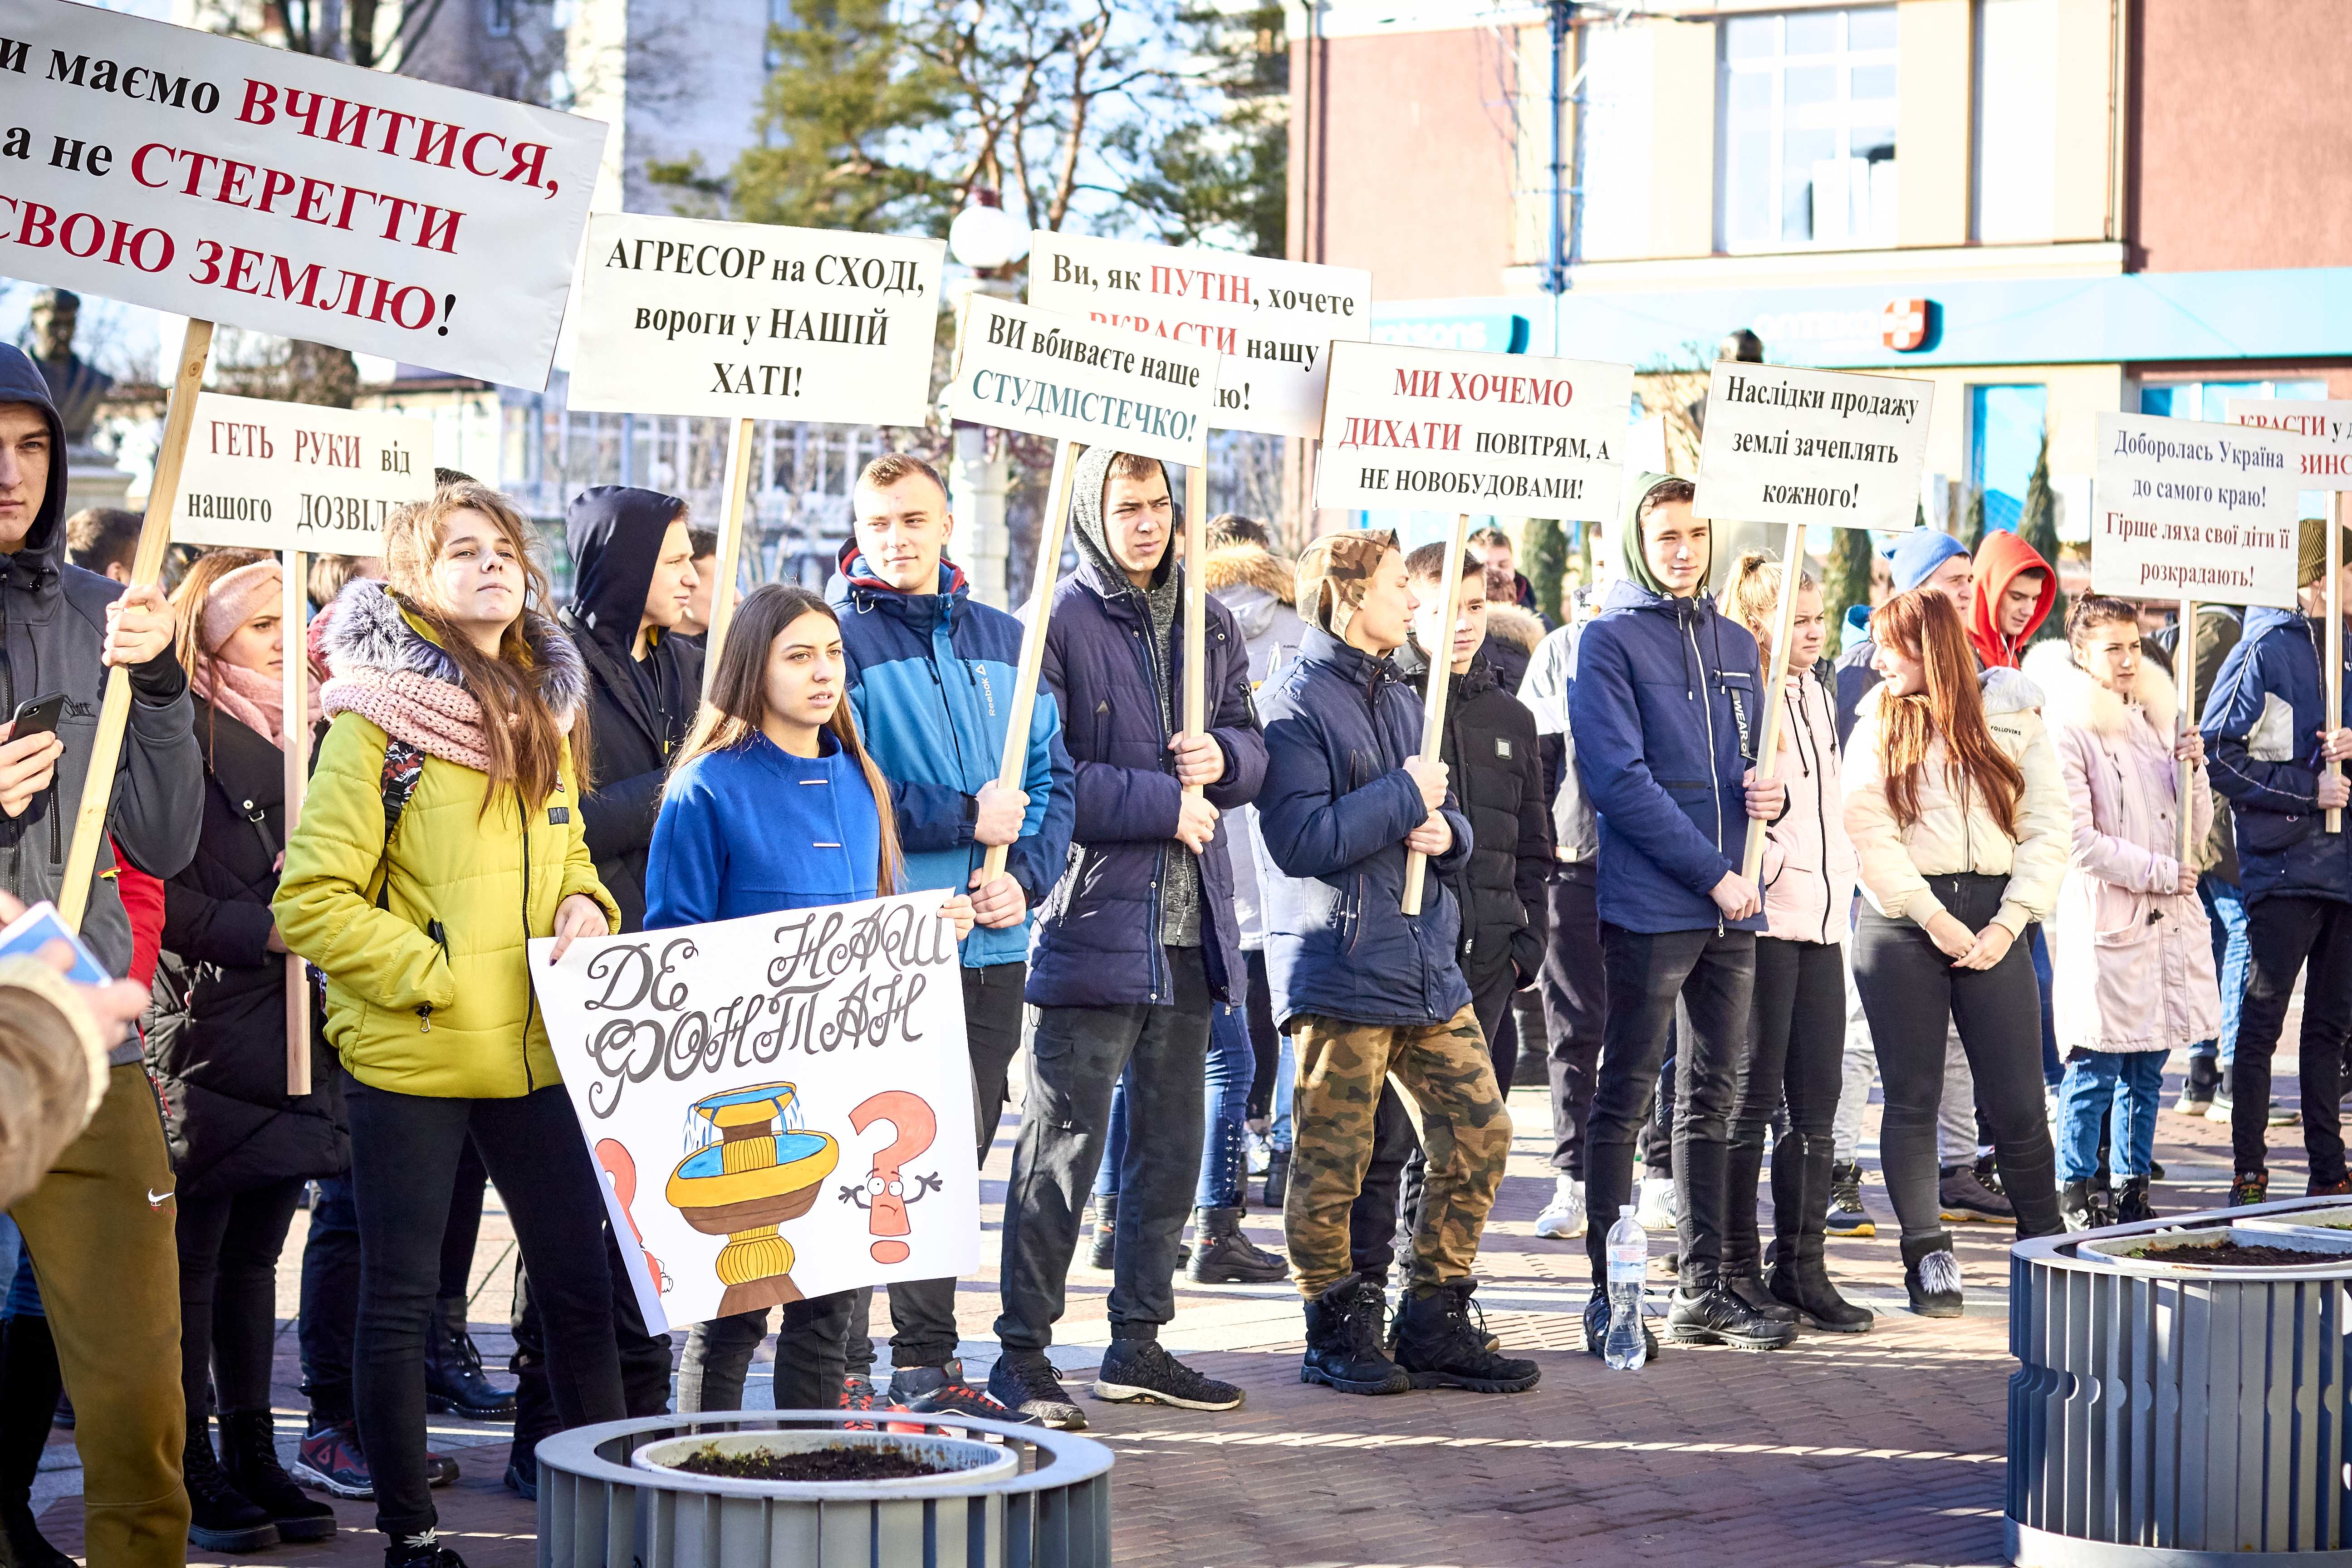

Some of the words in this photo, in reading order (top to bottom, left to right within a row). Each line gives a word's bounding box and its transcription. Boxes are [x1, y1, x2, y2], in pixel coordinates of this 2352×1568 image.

[45, 49, 219, 113] маємо
[235, 78, 558, 199] ВЧИТИСЯ,
[3, 127, 30, 159] а
[48, 136, 112, 176] не
[132, 143, 467, 254] СТЕРЕГТИ
[189, 239, 456, 336] ЗЕМЛЮ!
[605, 238, 764, 279] АГРЕСОР
[771, 260, 804, 282] на
[816, 255, 923, 298] СХОДІ,
[1053, 254, 1098, 291] Ви,
[1108, 270, 1140, 290] як
[1151, 265, 1259, 311] ПУТІН,
[1269, 289, 1353, 316] хочете
[635, 308, 735, 340] вороги
[744, 316, 760, 345] у
[768, 308, 890, 345] НАШІЙ
[987, 314, 1028, 350] ВИ
[1031, 328, 1134, 373] вбиваєте
[1140, 357, 1199, 387] наше
[1247, 339, 1319, 372] нашу
[710, 363, 801, 397] ХАТІ!
[1214, 383, 1249, 410] ю!
[1393, 369, 1442, 397] МИ
[1447, 372, 1572, 407] ХОЧЕМО
[1726, 376, 1825, 409] Наслідки
[1831, 392, 1918, 424] продажу
[973, 369, 1196, 442] СТУДМІСТЕЧКО!
[211, 421, 273, 458] ГЕТЬ
[295, 430, 360, 468] РУКИ
[382, 441, 410, 475] від
[1339, 417, 1463, 451] ДИХАТИ
[1475, 432, 1590, 461] ПОВІТРЯМ,
[1596, 441, 1610, 460] А
[1732, 430, 1788, 454] землі
[1794, 438, 1898, 463] зачеплять
[2115, 431, 2213, 462] Доборолась
[2220, 441, 2283, 471] Україна
[2332, 423, 2342, 442] у
[1359, 468, 1389, 489] НЕ
[1395, 470, 1583, 499] НОВОБУДОВАМИ!
[1763, 484, 1858, 508] кожного!
[2133, 480, 2151, 497] до
[2157, 483, 2212, 501] самого
[2219, 486, 2265, 510] краю!
[188, 494, 271, 522] нашого
[298, 494, 404, 534] ДОЗВІЛ
[2107, 513, 2157, 542] Гірше
[2162, 524, 2200, 542] ляха
[2206, 525, 2239, 544] свої
[2242, 528, 2274, 548] діти
[2280, 529, 2289, 549] її
[2141, 564, 2254, 588] розкрадають!
[981, 677, 995, 716] Reebok
[1733, 700, 1748, 740] WEAR
[585, 938, 698, 1011] ДЕ
[585, 973, 926, 1119] ФОНТАН
